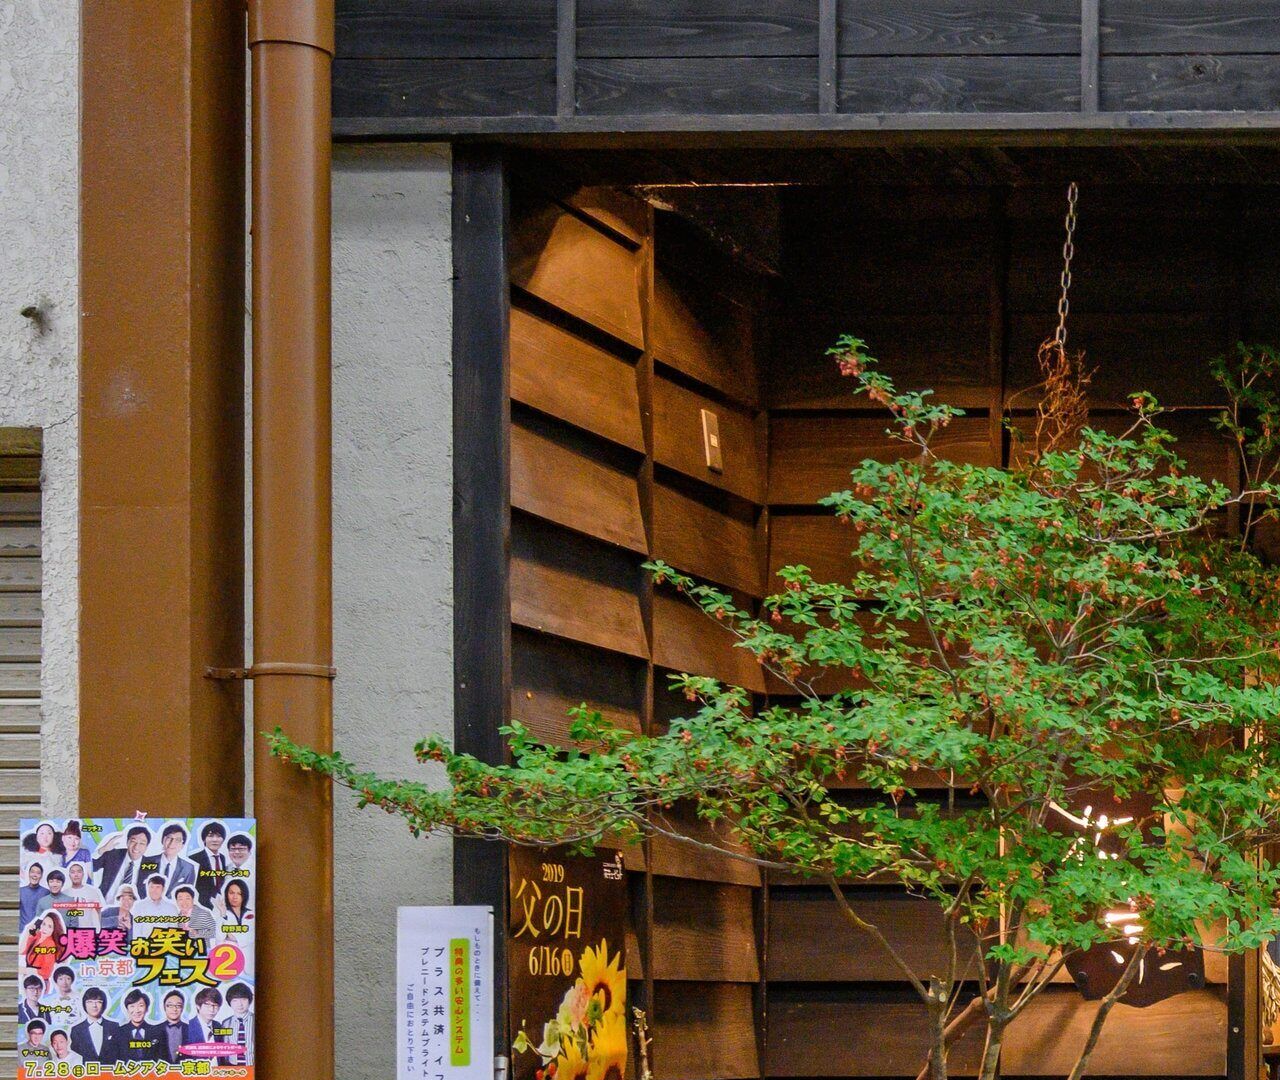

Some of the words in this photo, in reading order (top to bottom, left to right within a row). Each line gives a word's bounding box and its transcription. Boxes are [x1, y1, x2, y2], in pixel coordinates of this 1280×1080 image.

[542, 862, 565, 883] 2019
[514, 878, 584, 939] 父の日
[132, 957, 219, 988] フェス
[214, 945, 238, 976] 2
